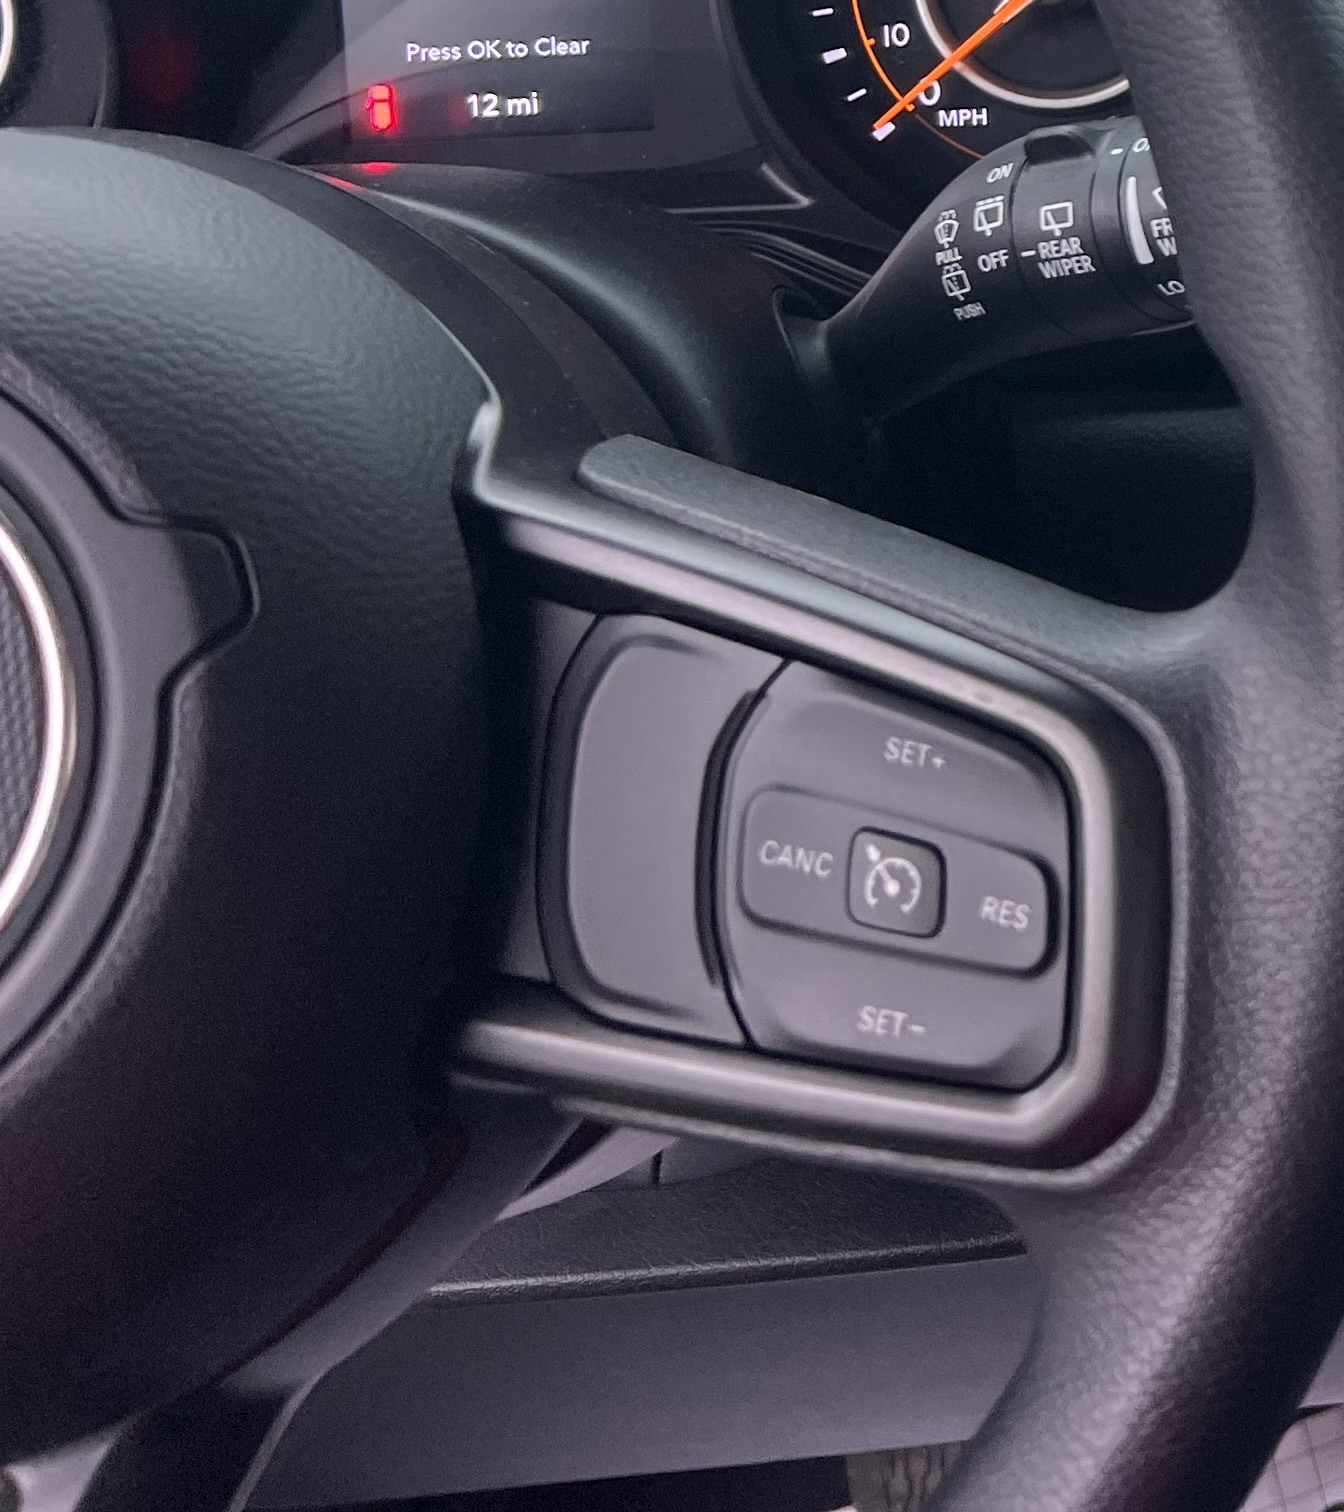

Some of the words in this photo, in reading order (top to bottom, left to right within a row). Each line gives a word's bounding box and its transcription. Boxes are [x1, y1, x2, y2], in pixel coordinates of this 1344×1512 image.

[883, 23, 910, 48] 10
[406, 43, 461, 62] Press
[467, 40, 501, 59] OK
[506, 40, 528, 57] to
[534, 36, 590, 57] Clear
[467, 92, 499, 117] 12
[506, 91, 539, 116] mi
[938, 108, 987, 127] MPH
[986, 162, 1014, 183] ON
[935, 247, 962, 266] PULL
[1037, 237, 1084, 259] REAR
[977, 249, 1010, 273] OFF
[1038, 255, 1096, 279] WIPER
[953, 302, 987, 321] PUSH
[759, 840, 835, 879] CANC
[979, 896, 1031, 931] RES
